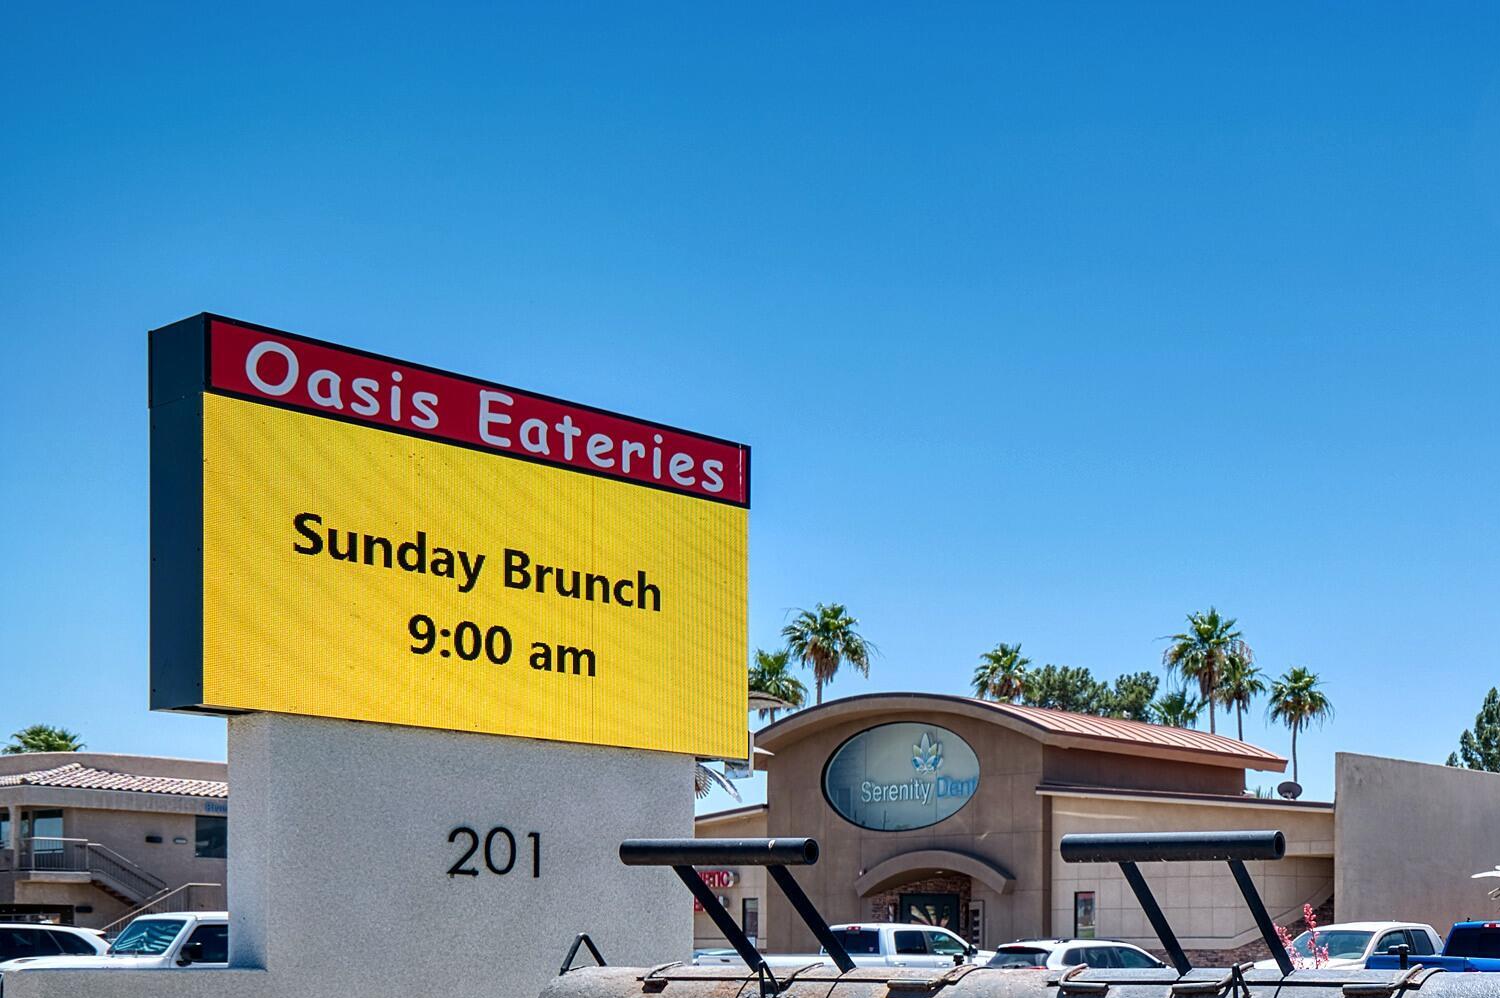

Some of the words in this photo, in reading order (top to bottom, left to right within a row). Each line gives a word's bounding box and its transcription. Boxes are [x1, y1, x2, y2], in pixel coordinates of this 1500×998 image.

[245, 340, 439, 430] Oasis
[478, 389, 724, 493] Eateries
[293, 512, 485, 593] Sunday
[503, 547, 662, 612] Brunch
[408, 614, 513, 665] 9:00
[529, 638, 597, 677] am
[861, 778, 932, 806] Serenity
[447, 826, 541, 878] 201
